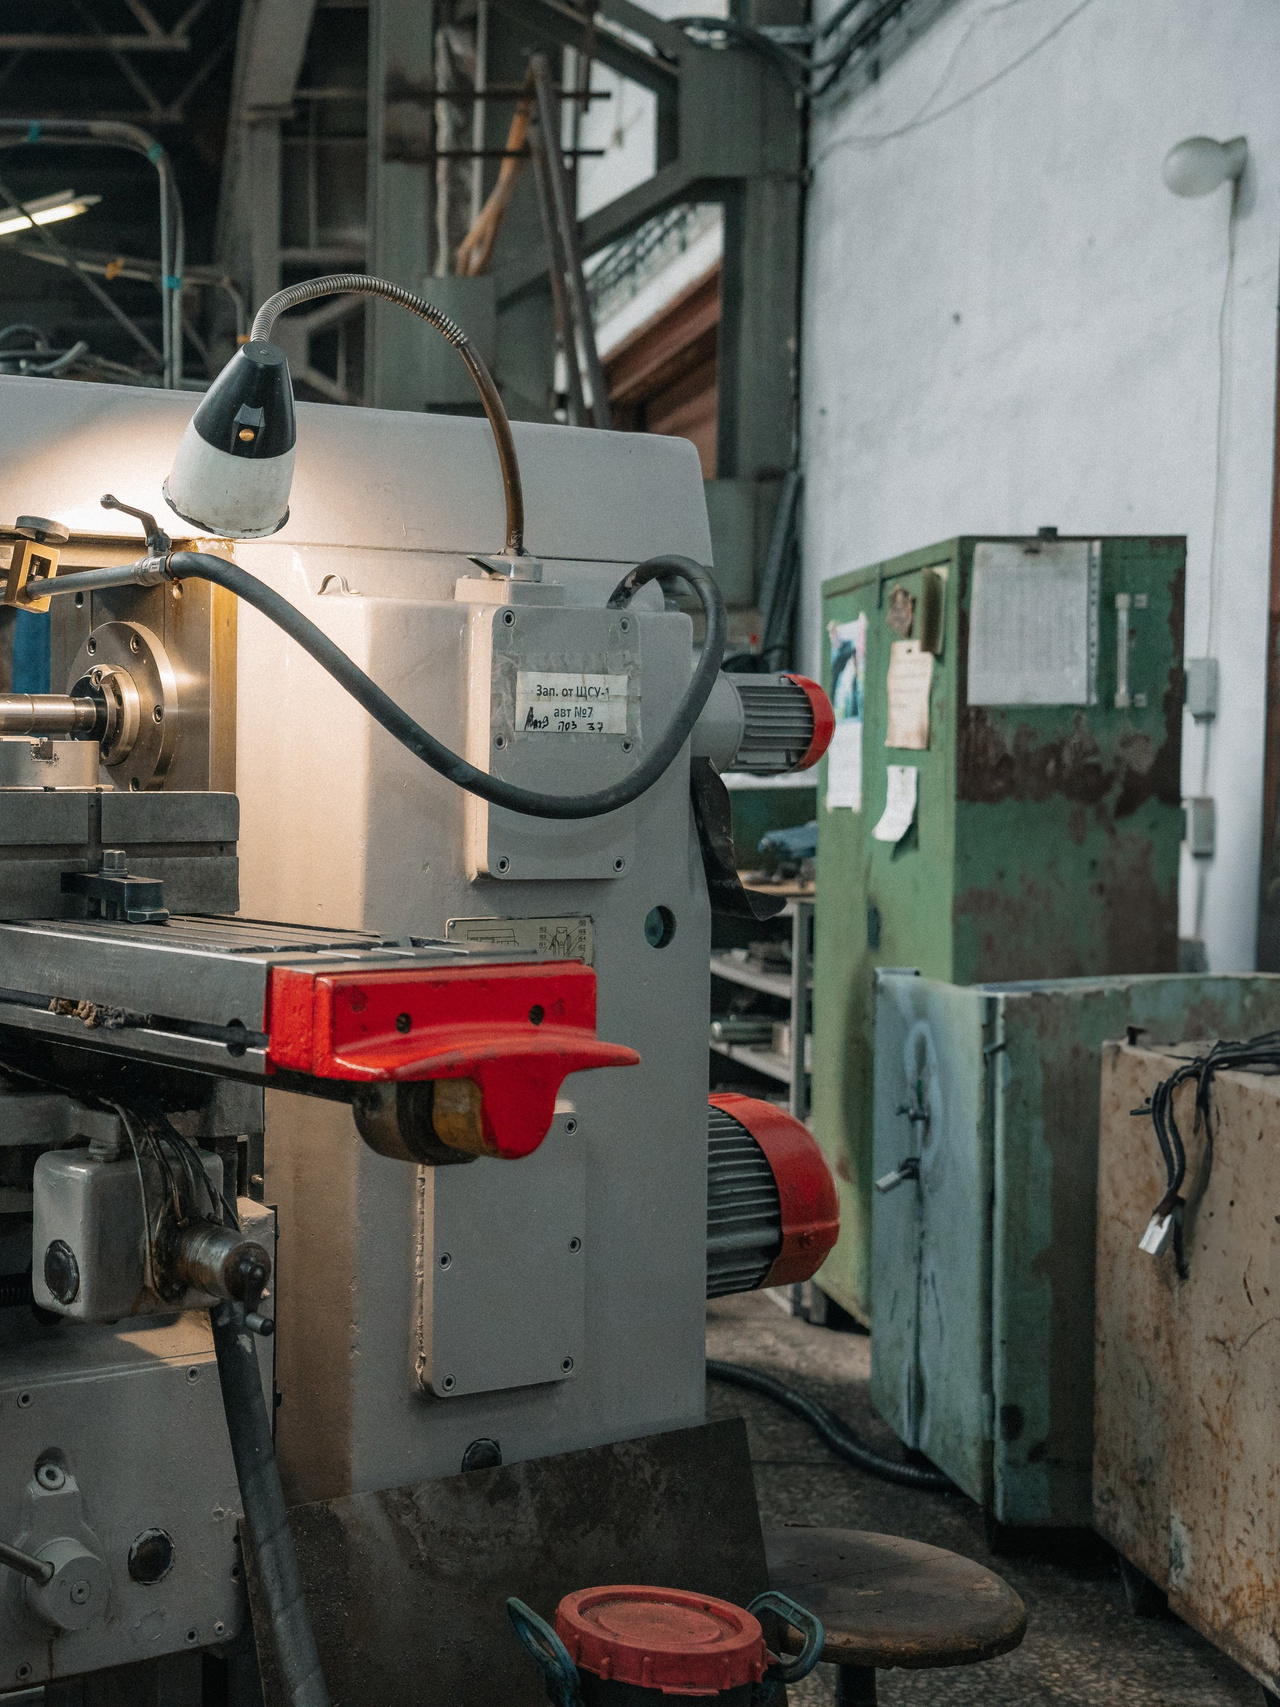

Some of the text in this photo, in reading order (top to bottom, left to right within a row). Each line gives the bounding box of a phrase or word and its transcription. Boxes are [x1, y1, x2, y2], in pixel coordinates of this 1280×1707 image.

[536, 685, 610, 700] Зап. от ЩСУ-1
[554, 708, 572, 718] авт
